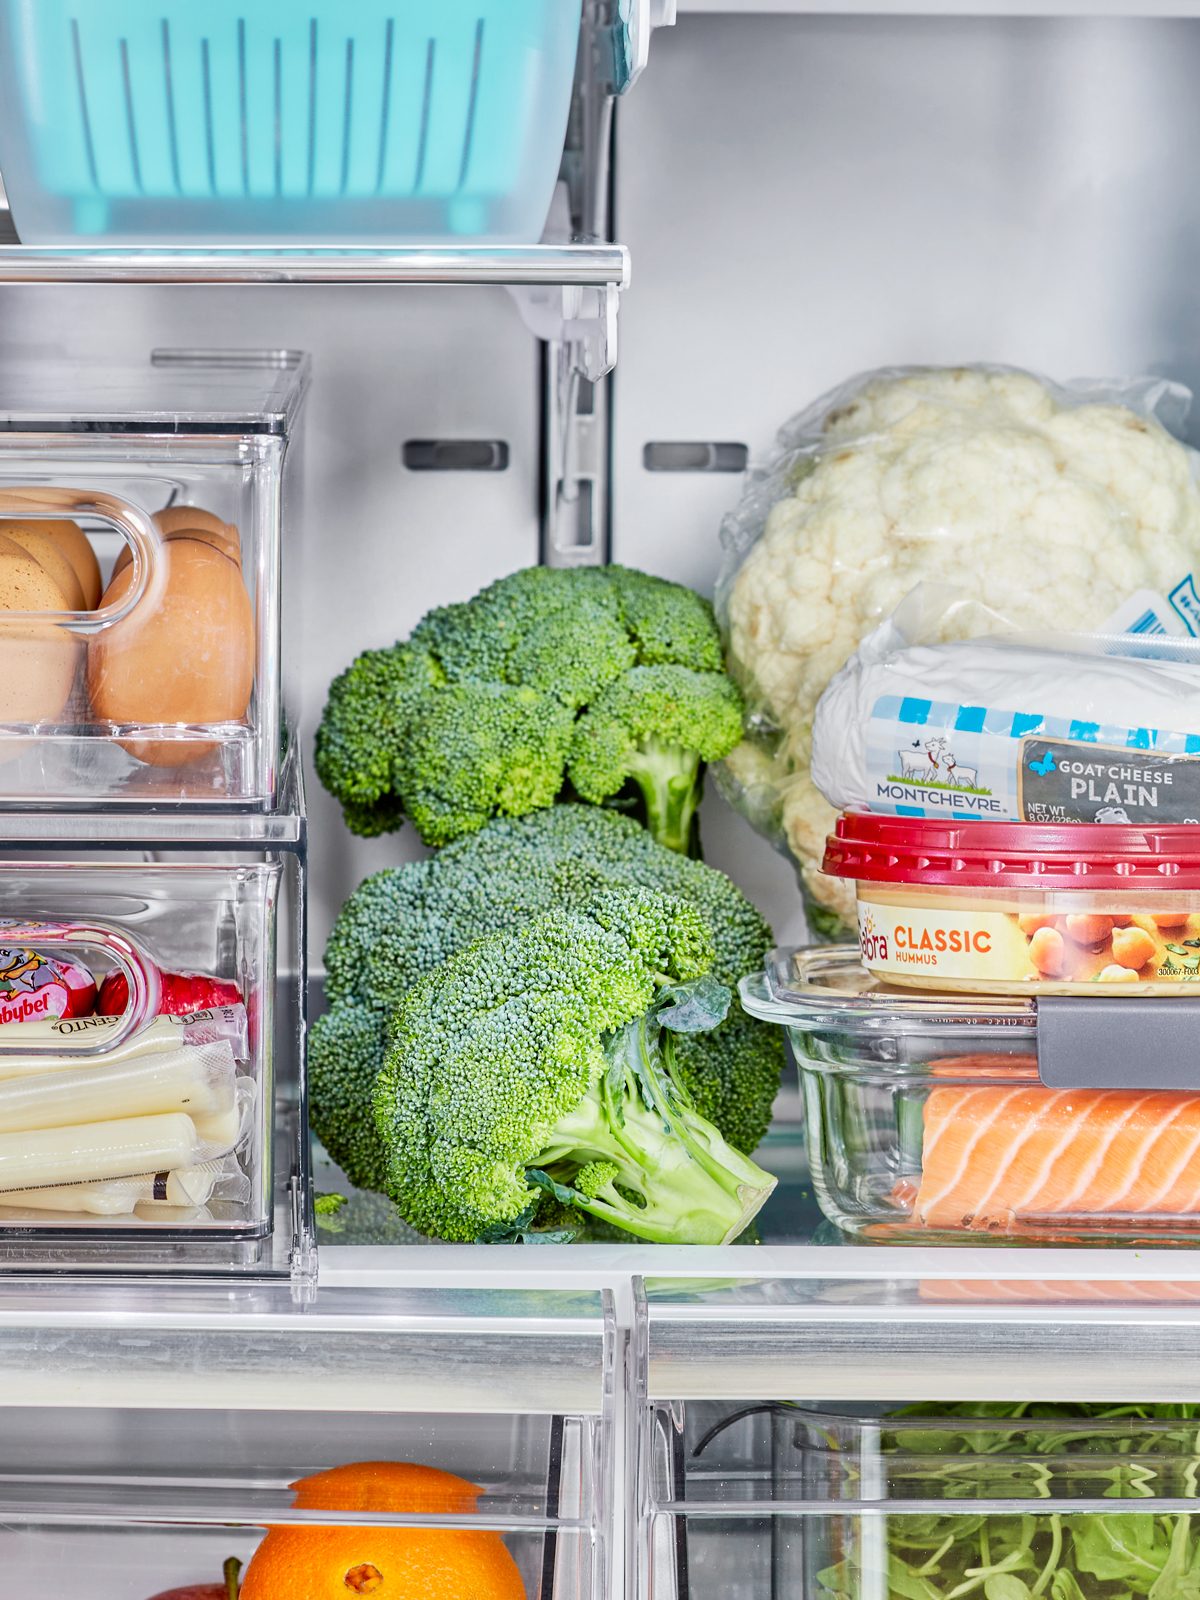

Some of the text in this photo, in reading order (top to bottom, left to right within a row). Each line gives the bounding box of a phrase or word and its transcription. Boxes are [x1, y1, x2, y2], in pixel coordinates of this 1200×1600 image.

[1058, 760, 1173, 785] GOAT CHEESE
[877, 783, 1001, 812] MONTCHEVRE
[1070, 777, 1158, 807] PLAIN
[1027, 802, 1065, 816] NET WT
[858, 919, 888, 961] abra
[894, 925, 992, 953] CLASSIC
[895, 951, 938, 965] HUMMUS
